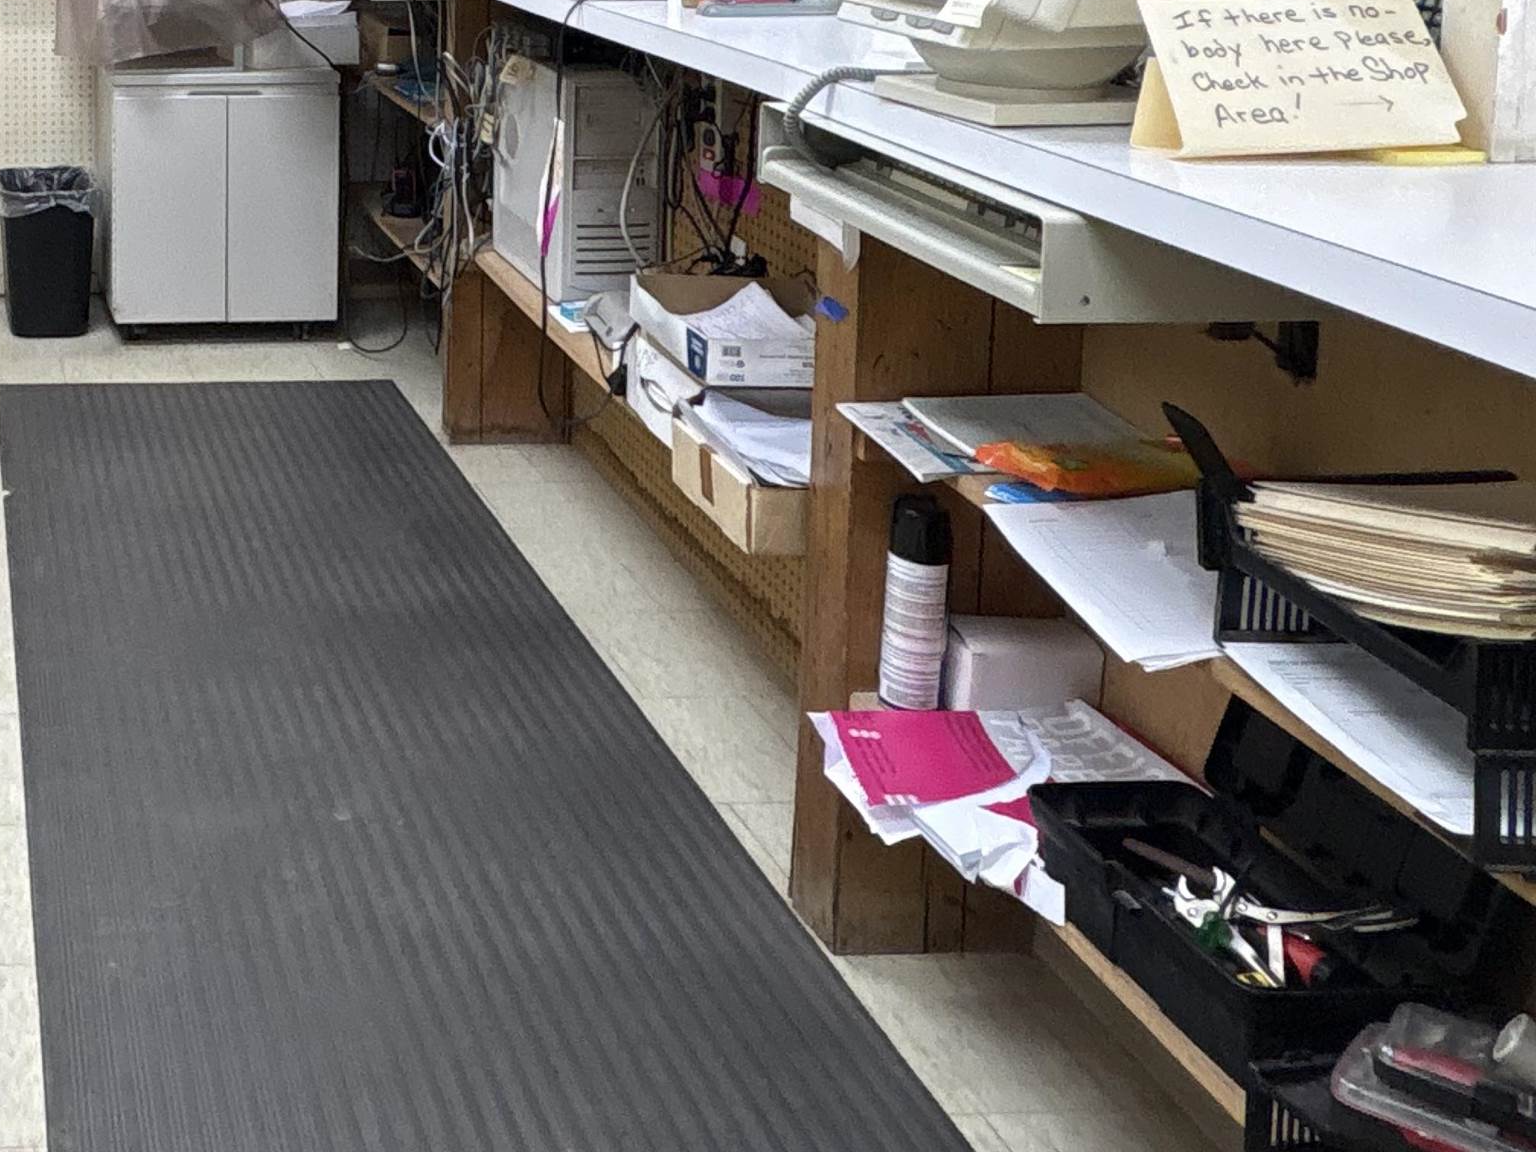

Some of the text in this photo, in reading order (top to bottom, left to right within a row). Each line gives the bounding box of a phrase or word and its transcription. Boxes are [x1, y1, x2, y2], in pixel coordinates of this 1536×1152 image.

[1172, 8, 1213, 31] If
[1224, 7, 1306, 27] there
[1310, 2, 1337, 21] is
[1181, 38, 1242, 68] body
[1259, 34, 1330, 54] here
[1191, 71, 1269, 92] Check
[1276, 64, 1305, 87] in
[1308, 65, 1364, 85] the
[1214, 92, 1301, 128] Area!
